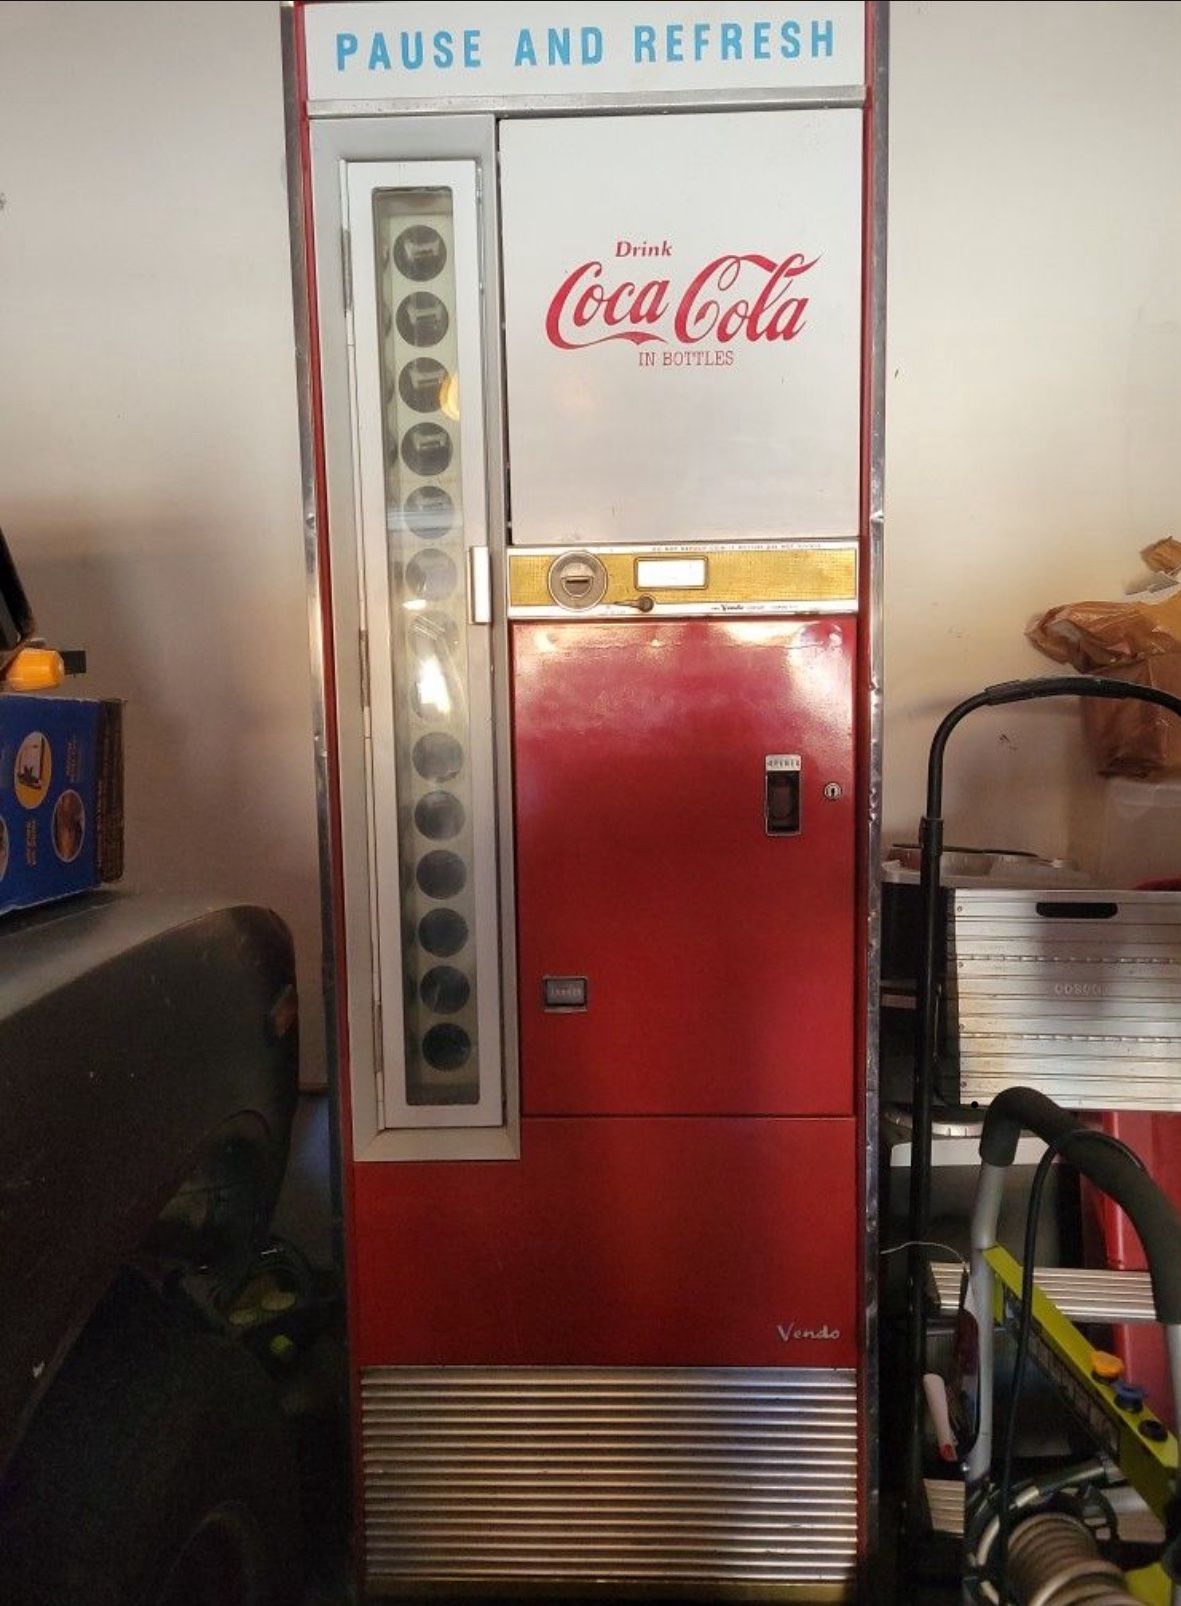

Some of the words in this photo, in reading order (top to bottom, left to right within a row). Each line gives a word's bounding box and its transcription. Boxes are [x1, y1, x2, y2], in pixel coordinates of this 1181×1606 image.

[335, 29, 481, 71] PAUSE
[513, 26, 604, 66] AND
[633, 19, 834, 63] REFRESH
[615, 241, 673, 258] Drink
[544, 260, 671, 350] Coca
[673, 252, 823, 345] Cola
[638, 351, 656, 367] IN
[662, 350, 735, 366] BOTTLES
[776, 1321, 841, 1342] Vendo
